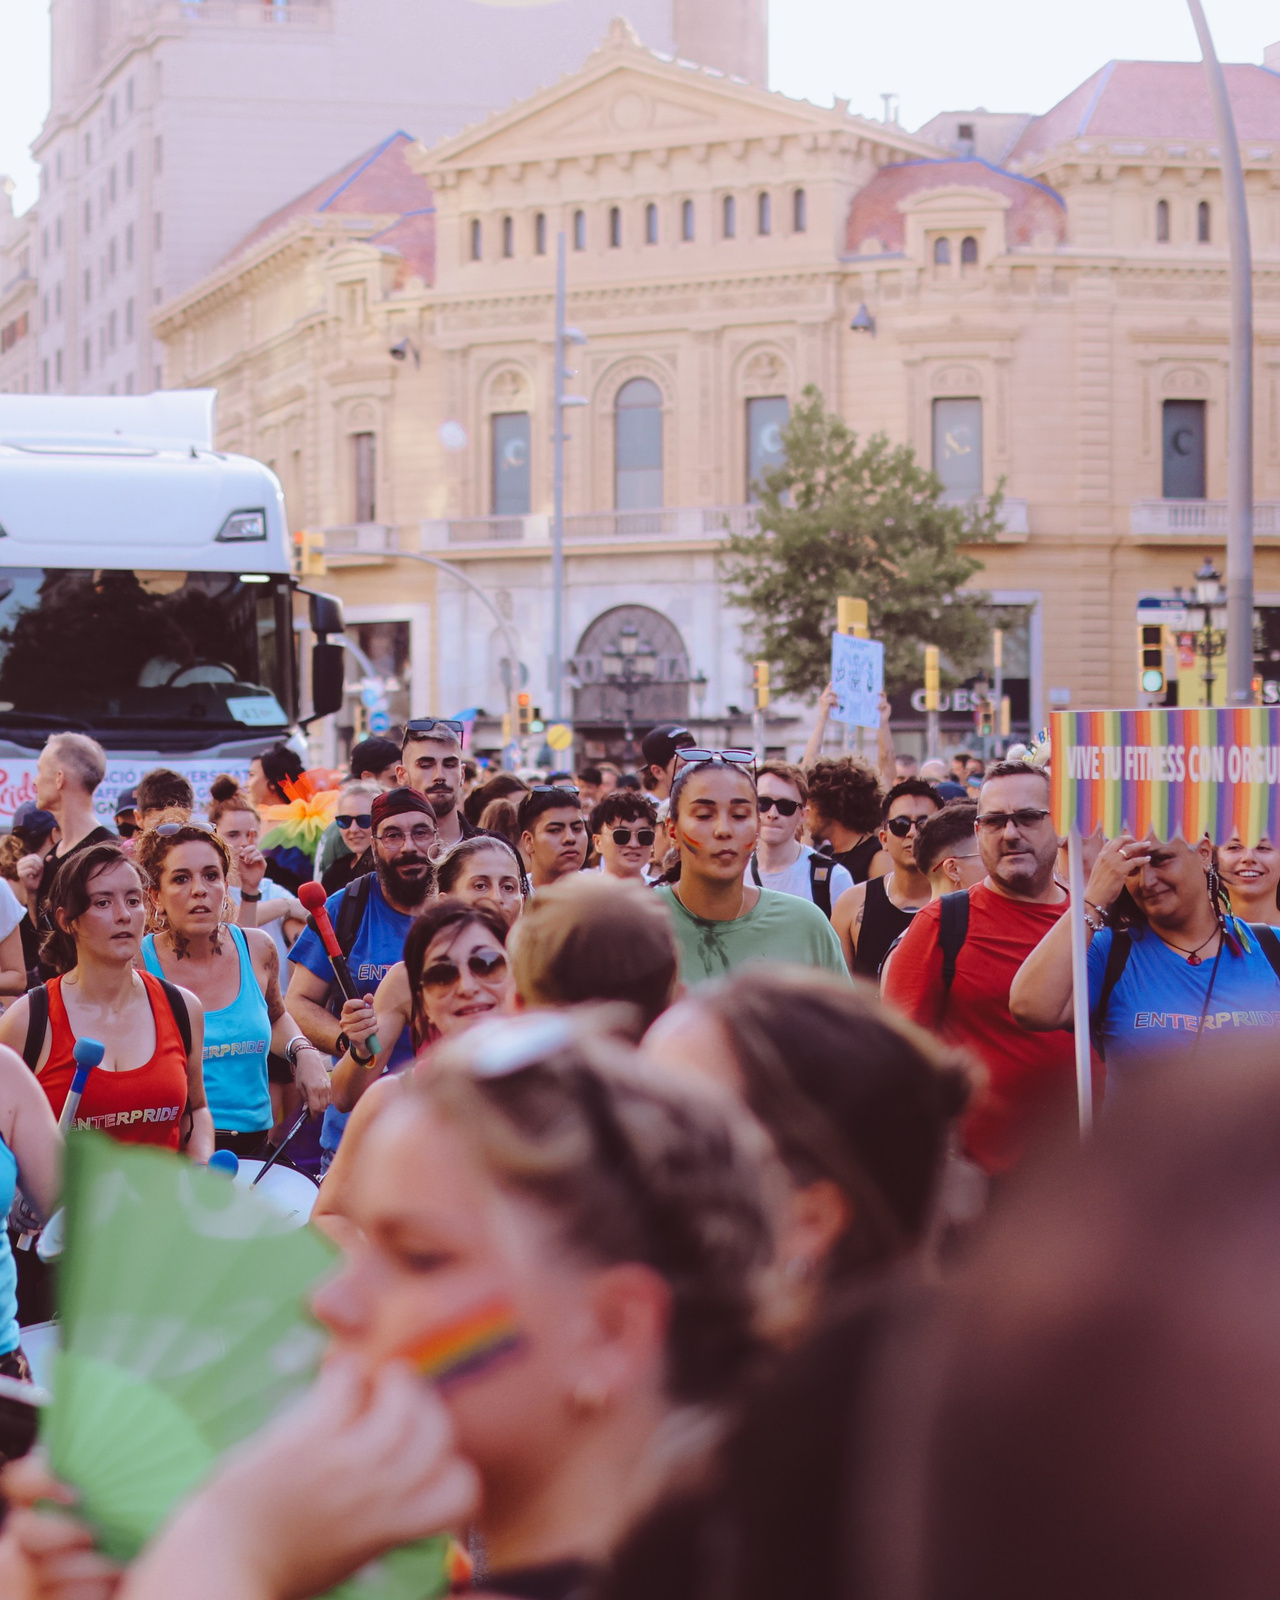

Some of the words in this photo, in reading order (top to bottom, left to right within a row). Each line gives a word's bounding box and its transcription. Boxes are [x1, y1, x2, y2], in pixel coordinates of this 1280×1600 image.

[1263, 680, 1280, 704] S
[1066, 745, 1100, 780] VIVE
[1101, 745, 1122, 781] TU
[1124, 745, 1186, 782] FITNESS
[1188, 745, 1224, 783] CON
[1227, 744, 1280, 785] ORGU
